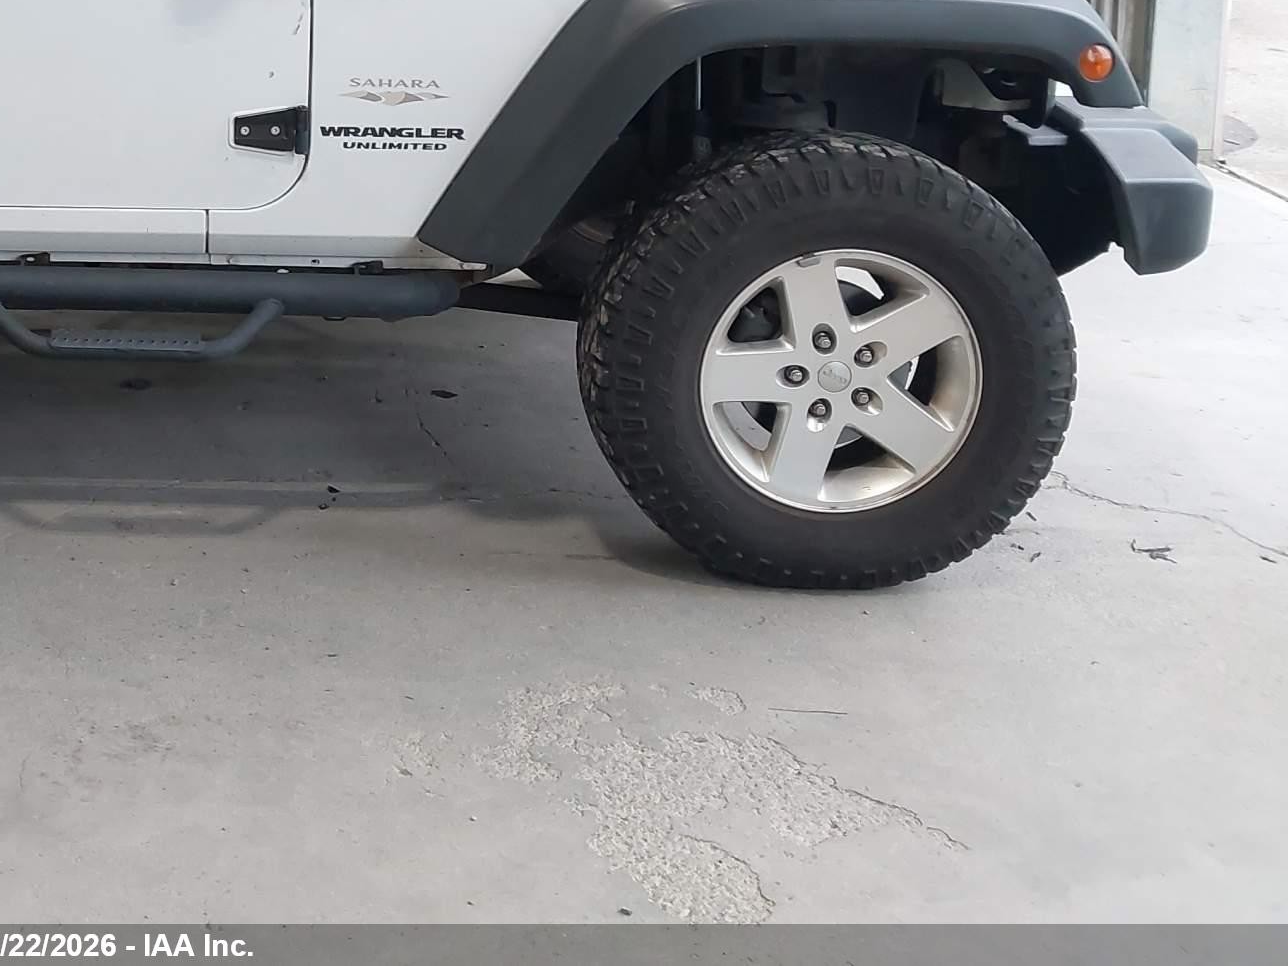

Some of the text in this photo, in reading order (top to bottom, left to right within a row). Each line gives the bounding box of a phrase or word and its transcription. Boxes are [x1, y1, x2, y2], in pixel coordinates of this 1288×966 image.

[349, 77, 441, 89] SAHARA
[319, 126, 466, 141] WRANGLER
[342, 141, 448, 151] UNLIMITED
